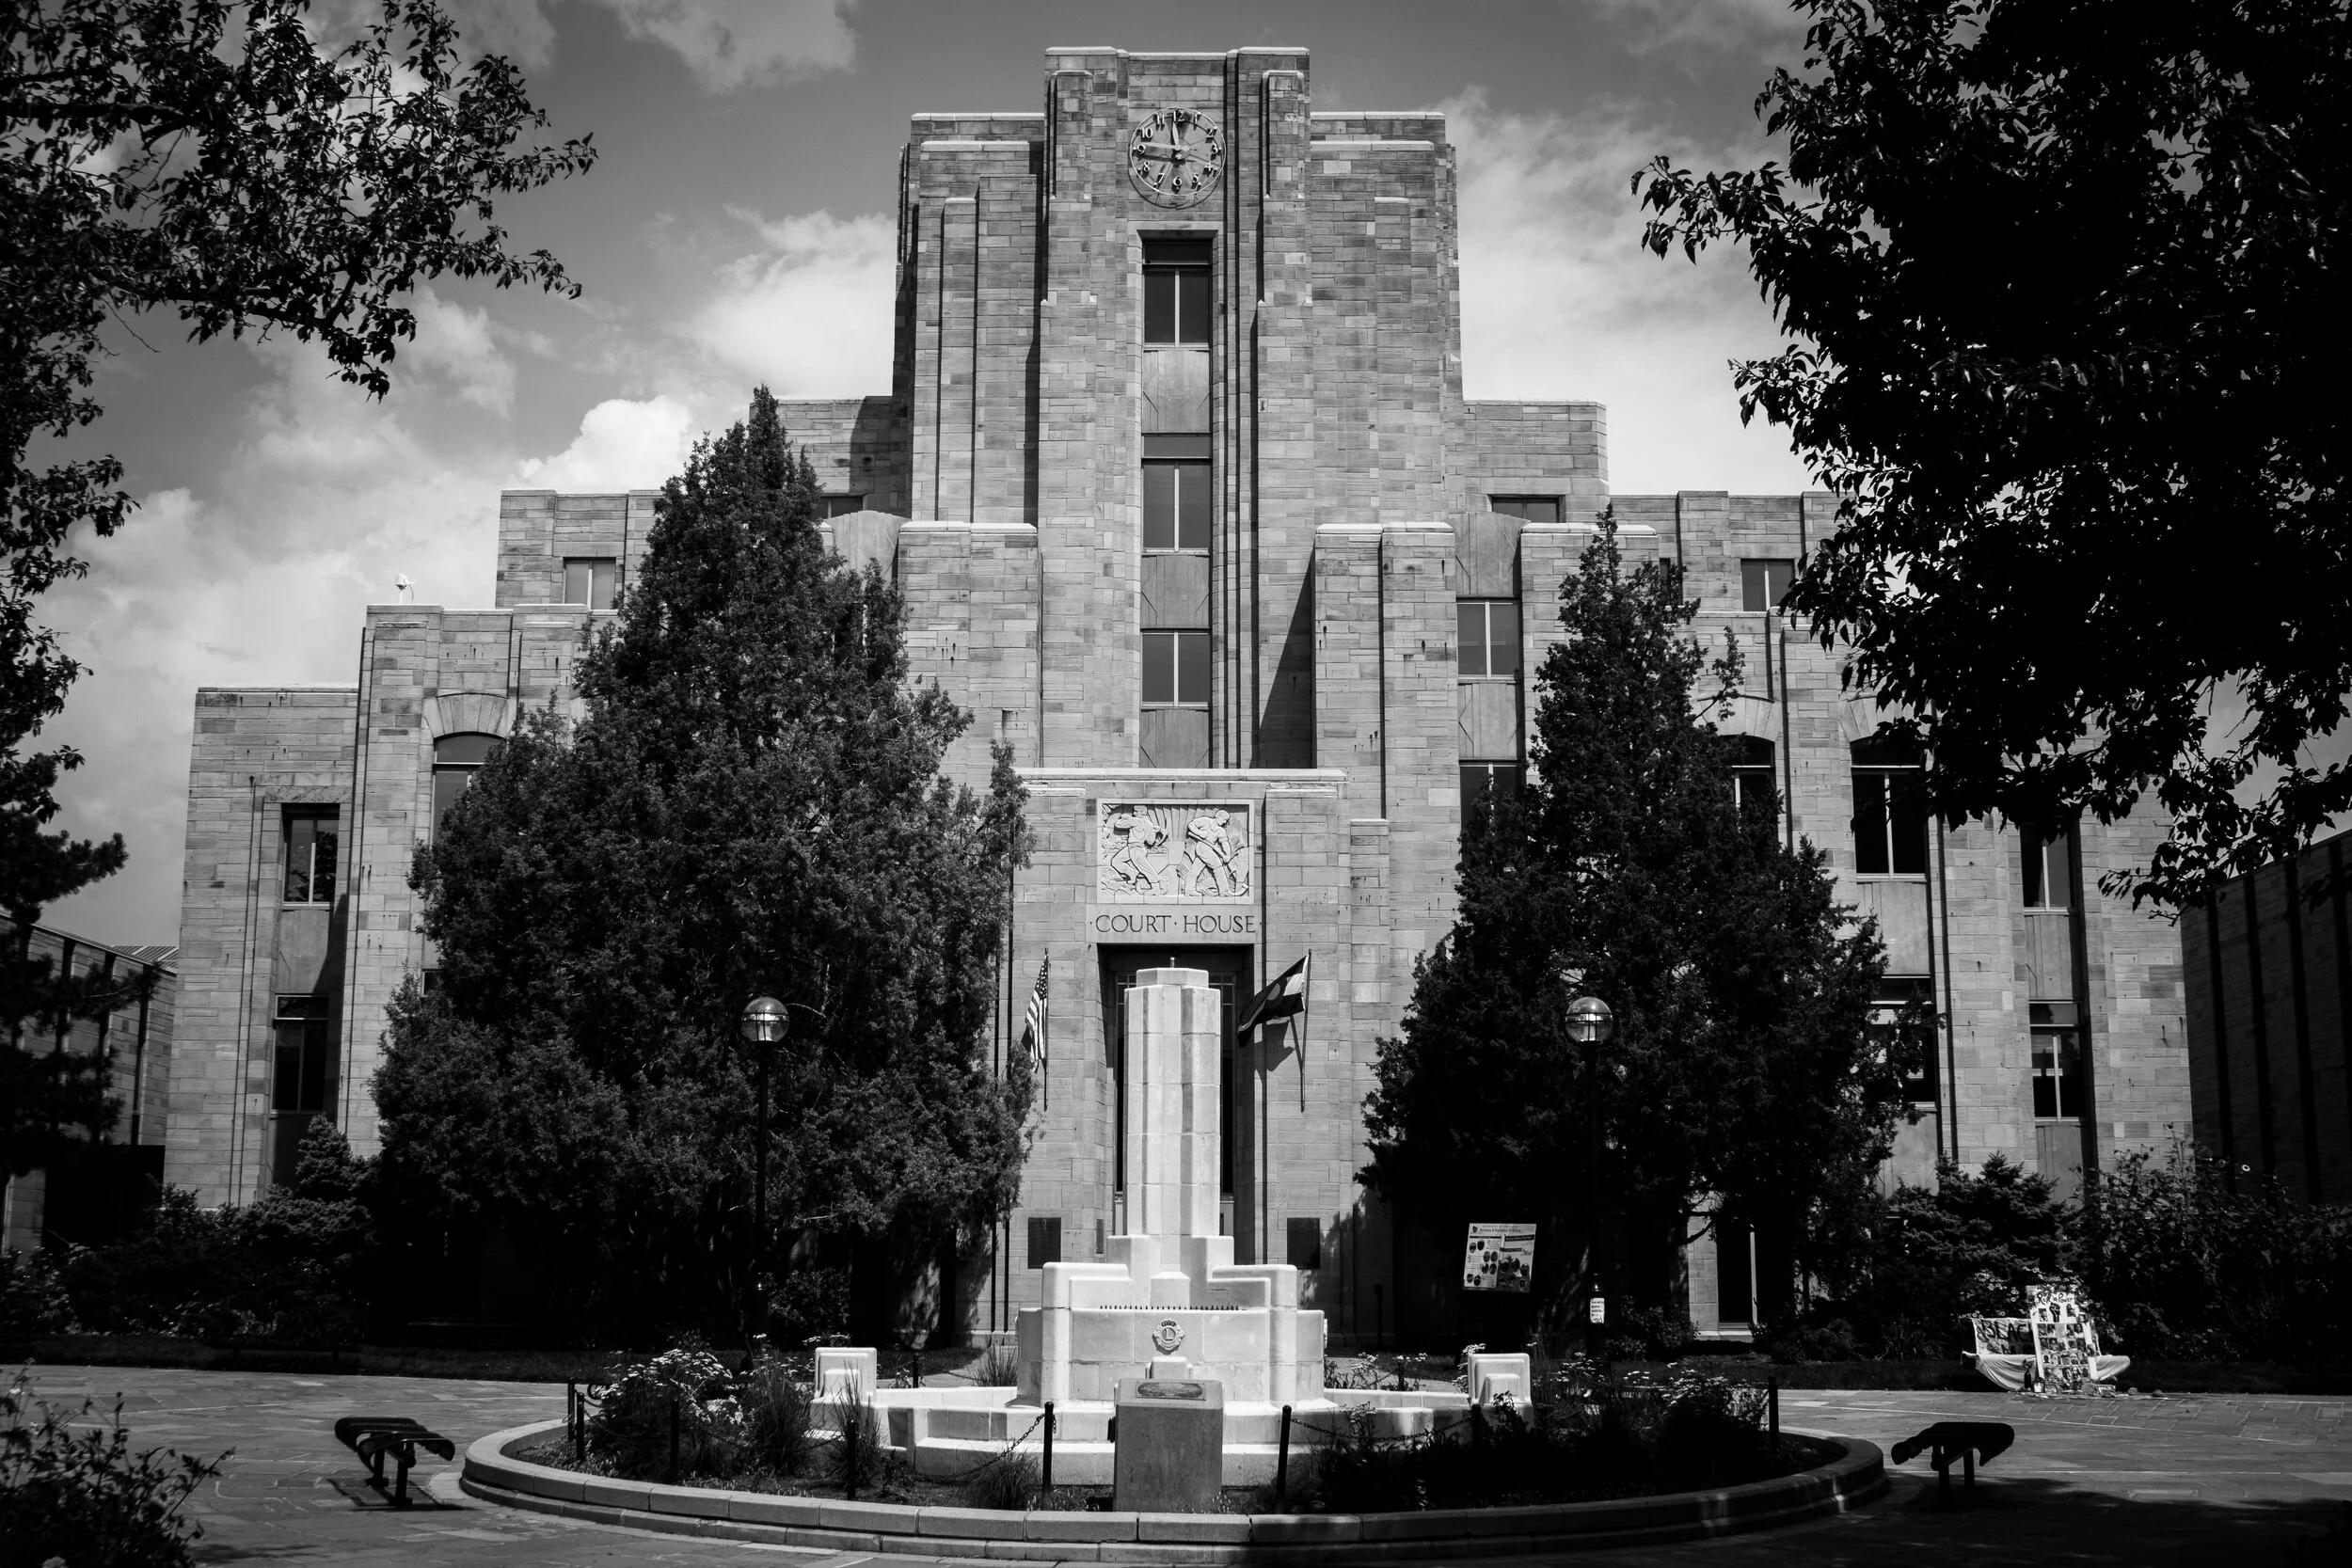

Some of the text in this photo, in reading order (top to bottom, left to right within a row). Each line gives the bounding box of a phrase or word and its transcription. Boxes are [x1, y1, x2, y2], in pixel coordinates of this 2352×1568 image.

[1156, 114, 1165, 125] 11
[1173, 110, 1185, 122] 12
[1140, 127, 1153, 138] 10
[1206, 128, 1214, 137] 2
[1136, 144, 1146, 154] 9
[1211, 143, 1218, 154] 3
[1143, 161, 1151, 172] 8
[1204, 161, 1213, 172] 4
[1158, 173, 1165, 183] 7
[1172, 176, 1183, 186] 6
[1192, 173, 1199, 183] 5
[1095, 914, 1257, 933] COURT HOUSE
